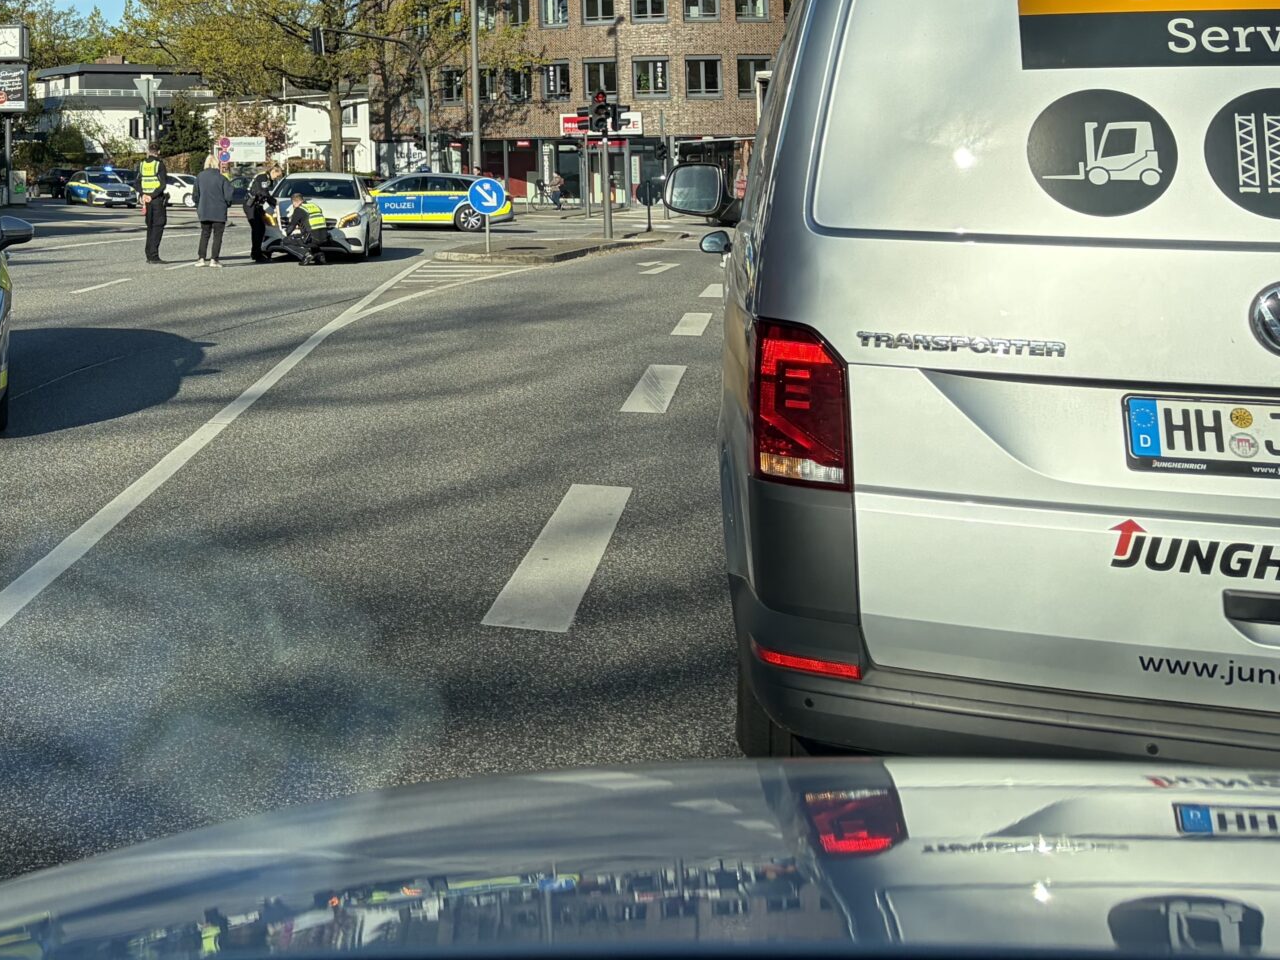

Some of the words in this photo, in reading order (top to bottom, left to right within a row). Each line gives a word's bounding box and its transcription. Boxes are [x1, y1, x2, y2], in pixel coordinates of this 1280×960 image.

[1167, 17, 1280, 54] Serv
[856, 330, 1067, 358] TRANSPORTER
[1139, 434, 1152, 448] D
[1163, 407, 1225, 453] HH
[1138, 655, 1280, 686] www.jun
